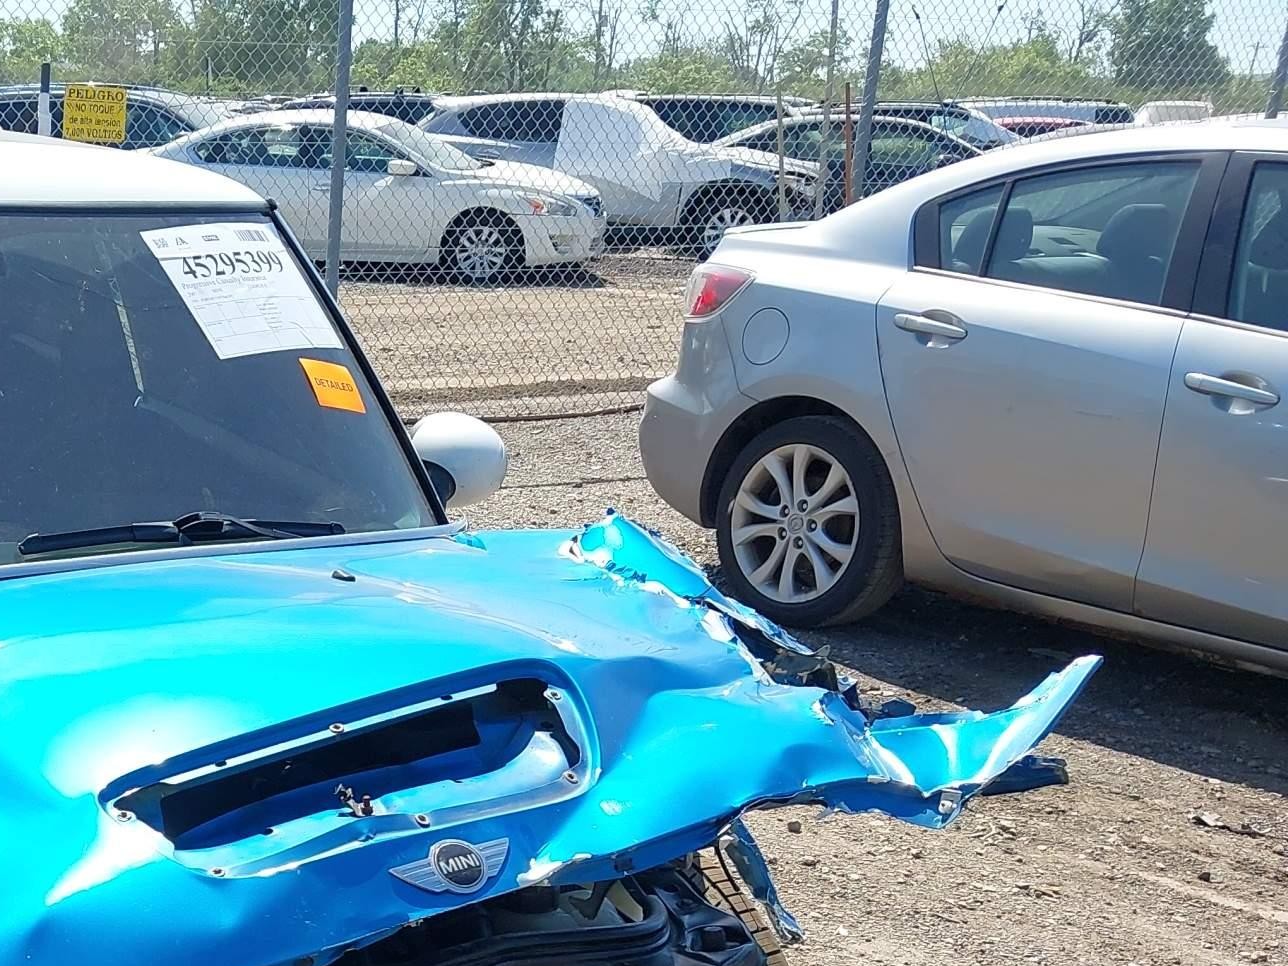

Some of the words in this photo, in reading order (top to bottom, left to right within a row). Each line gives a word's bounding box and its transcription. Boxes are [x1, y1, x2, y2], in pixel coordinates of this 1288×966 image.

[67, 88, 124, 102] PELIGRO
[75, 103, 87, 113] NO
[89, 103, 115, 114] TOQUE
[69, 115, 79, 125] de
[86, 128, 123, 140] VOLTIOS
[182, 250, 283, 279] 45295399
[314, 377, 353, 392] DETAILED
[439, 853, 480, 874] MINI
